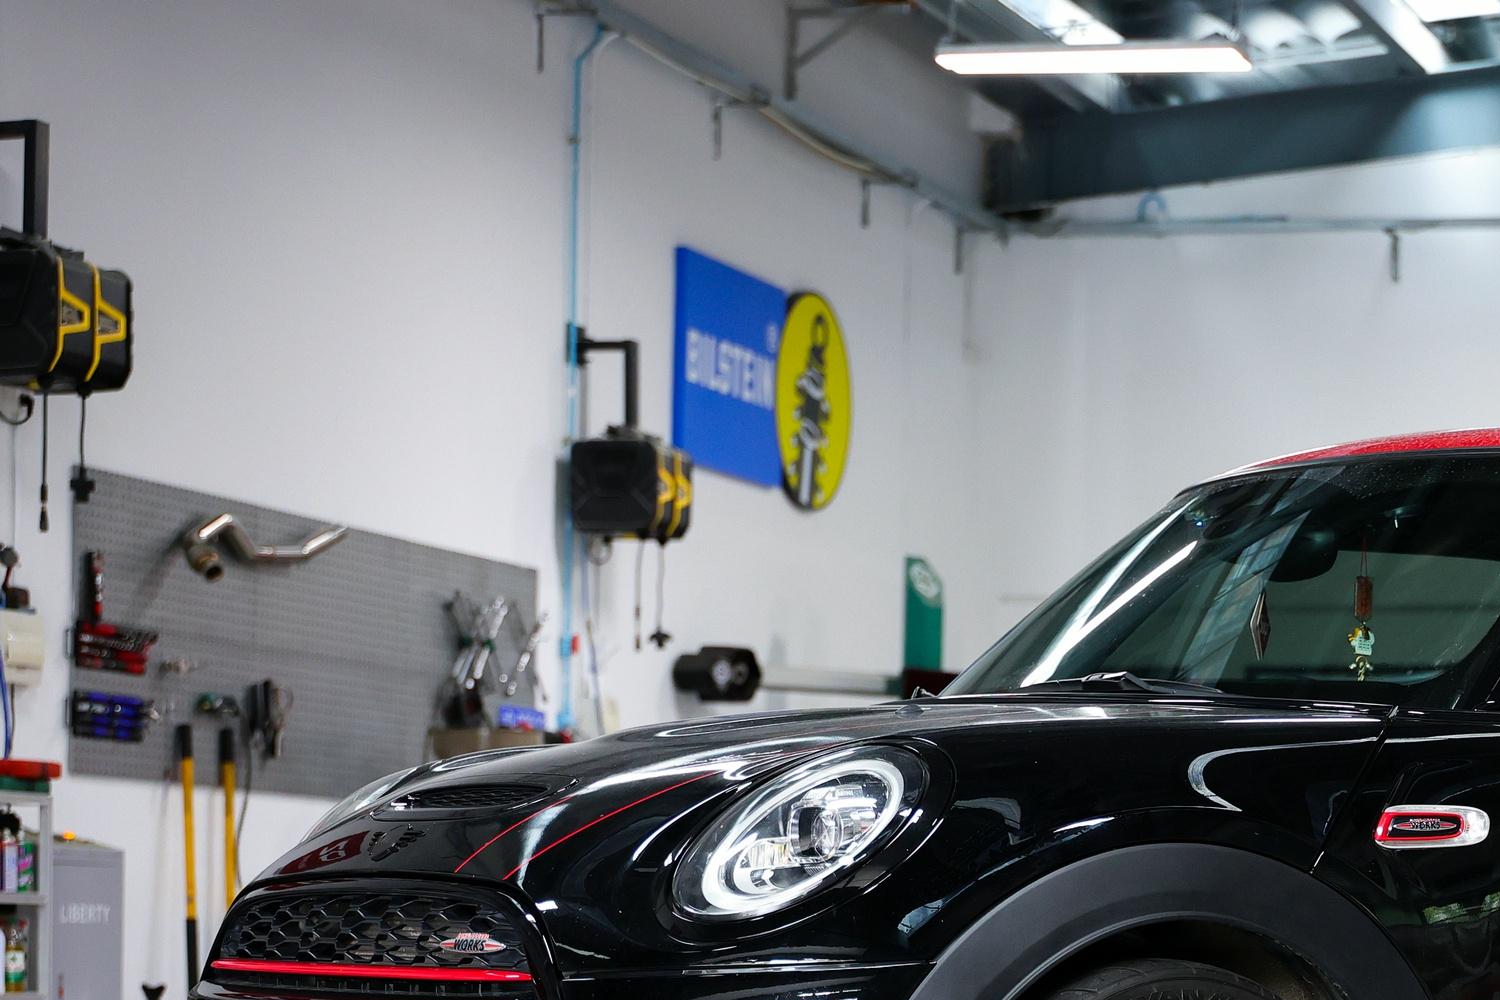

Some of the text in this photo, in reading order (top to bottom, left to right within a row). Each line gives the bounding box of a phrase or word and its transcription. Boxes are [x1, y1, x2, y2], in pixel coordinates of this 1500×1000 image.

[685, 327, 777, 411] BILSTEIN
[60, 903, 111, 924] LIBERTY
[453, 939, 487, 951] WORKS
